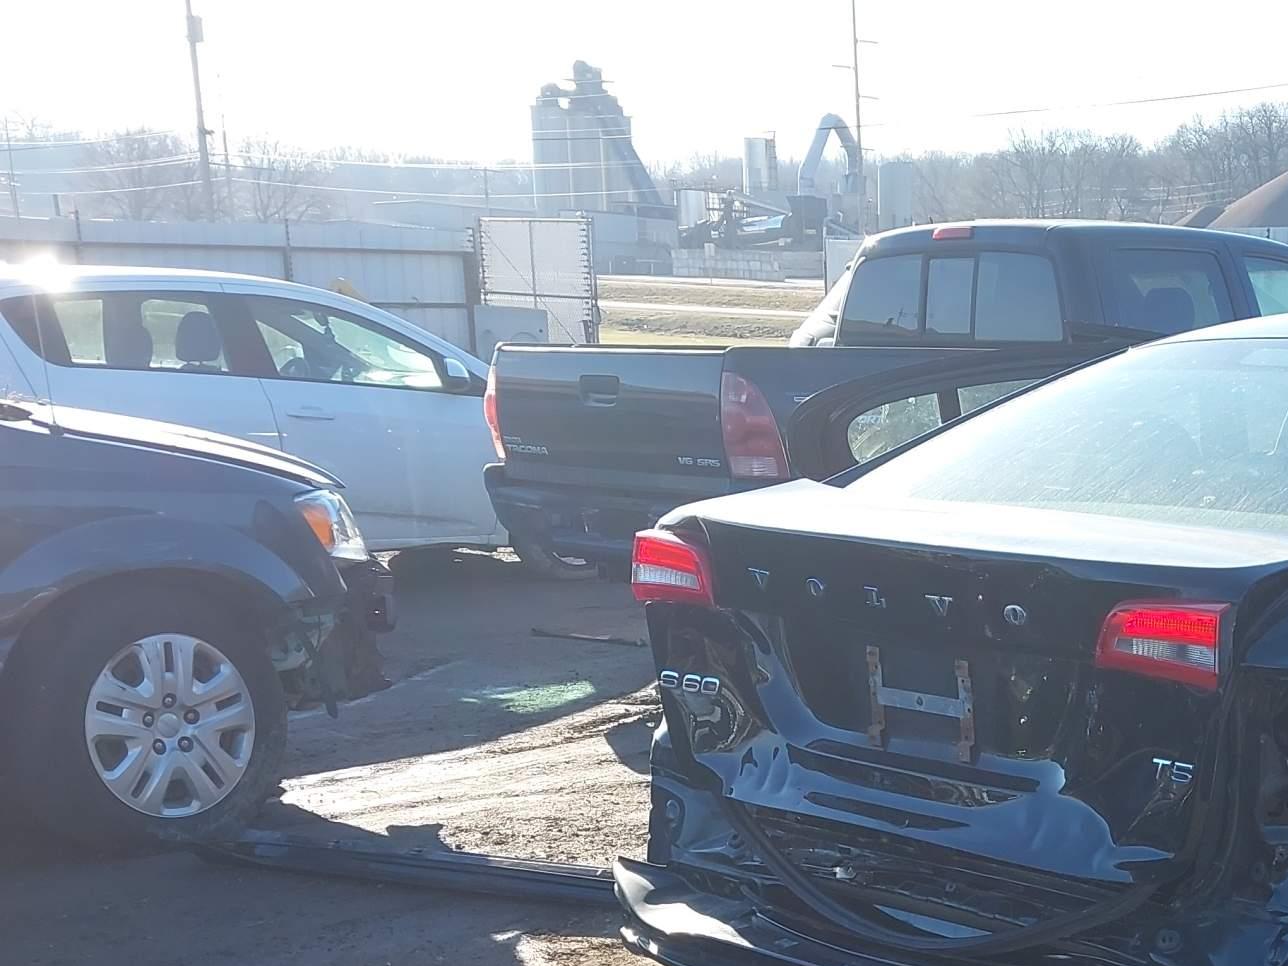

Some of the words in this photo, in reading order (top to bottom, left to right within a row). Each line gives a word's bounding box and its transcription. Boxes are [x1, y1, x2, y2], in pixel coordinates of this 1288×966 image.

[677, 456, 693, 465] V6
[747, 567, 1027, 626] VOLVO
[660, 670, 720, 695] S60
[1152, 757, 1194, 783] T5
